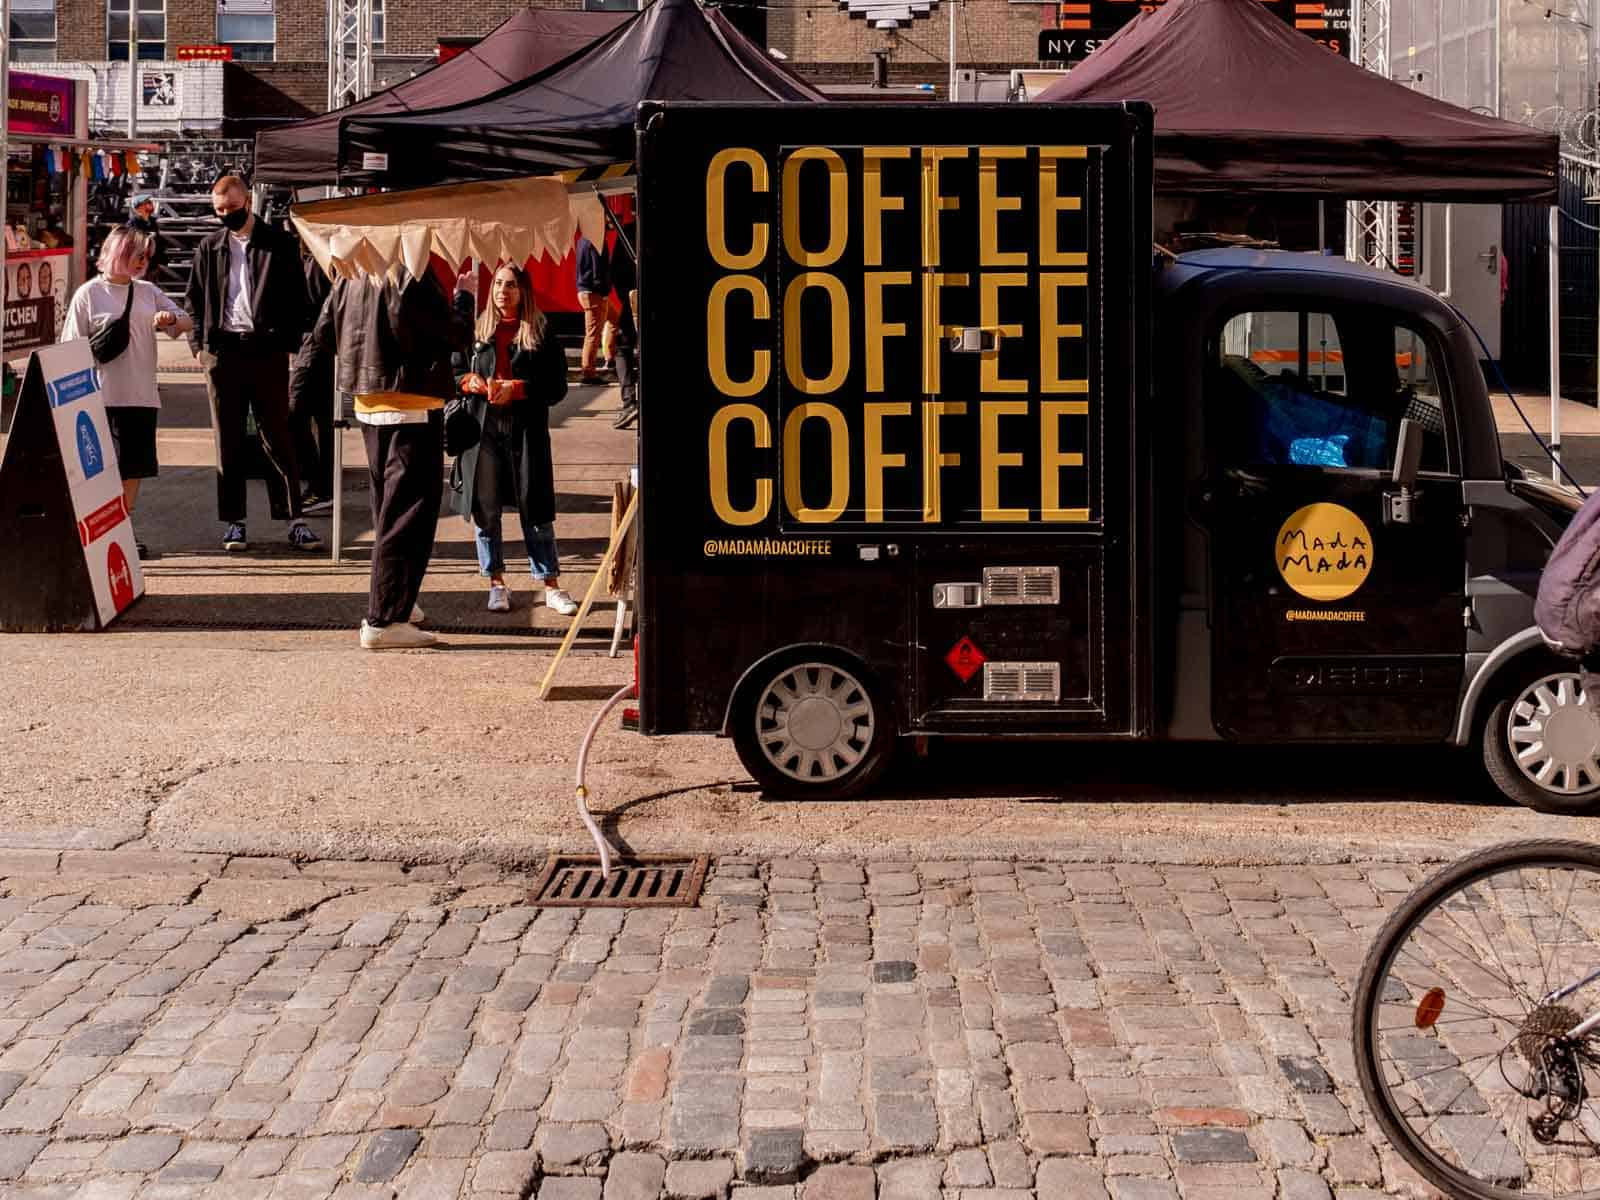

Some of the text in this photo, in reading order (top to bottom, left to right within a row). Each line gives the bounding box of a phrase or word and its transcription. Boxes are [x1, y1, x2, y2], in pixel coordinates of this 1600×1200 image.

[1048, 39, 1076, 54] NY
[706, 146, 1089, 270] COFFEE
[707, 272, 1089, 397] COFFEE
[708, 402, 1089, 526] COFFEE
[703, 539, 832, 557] @MADAMADACOFFEE
